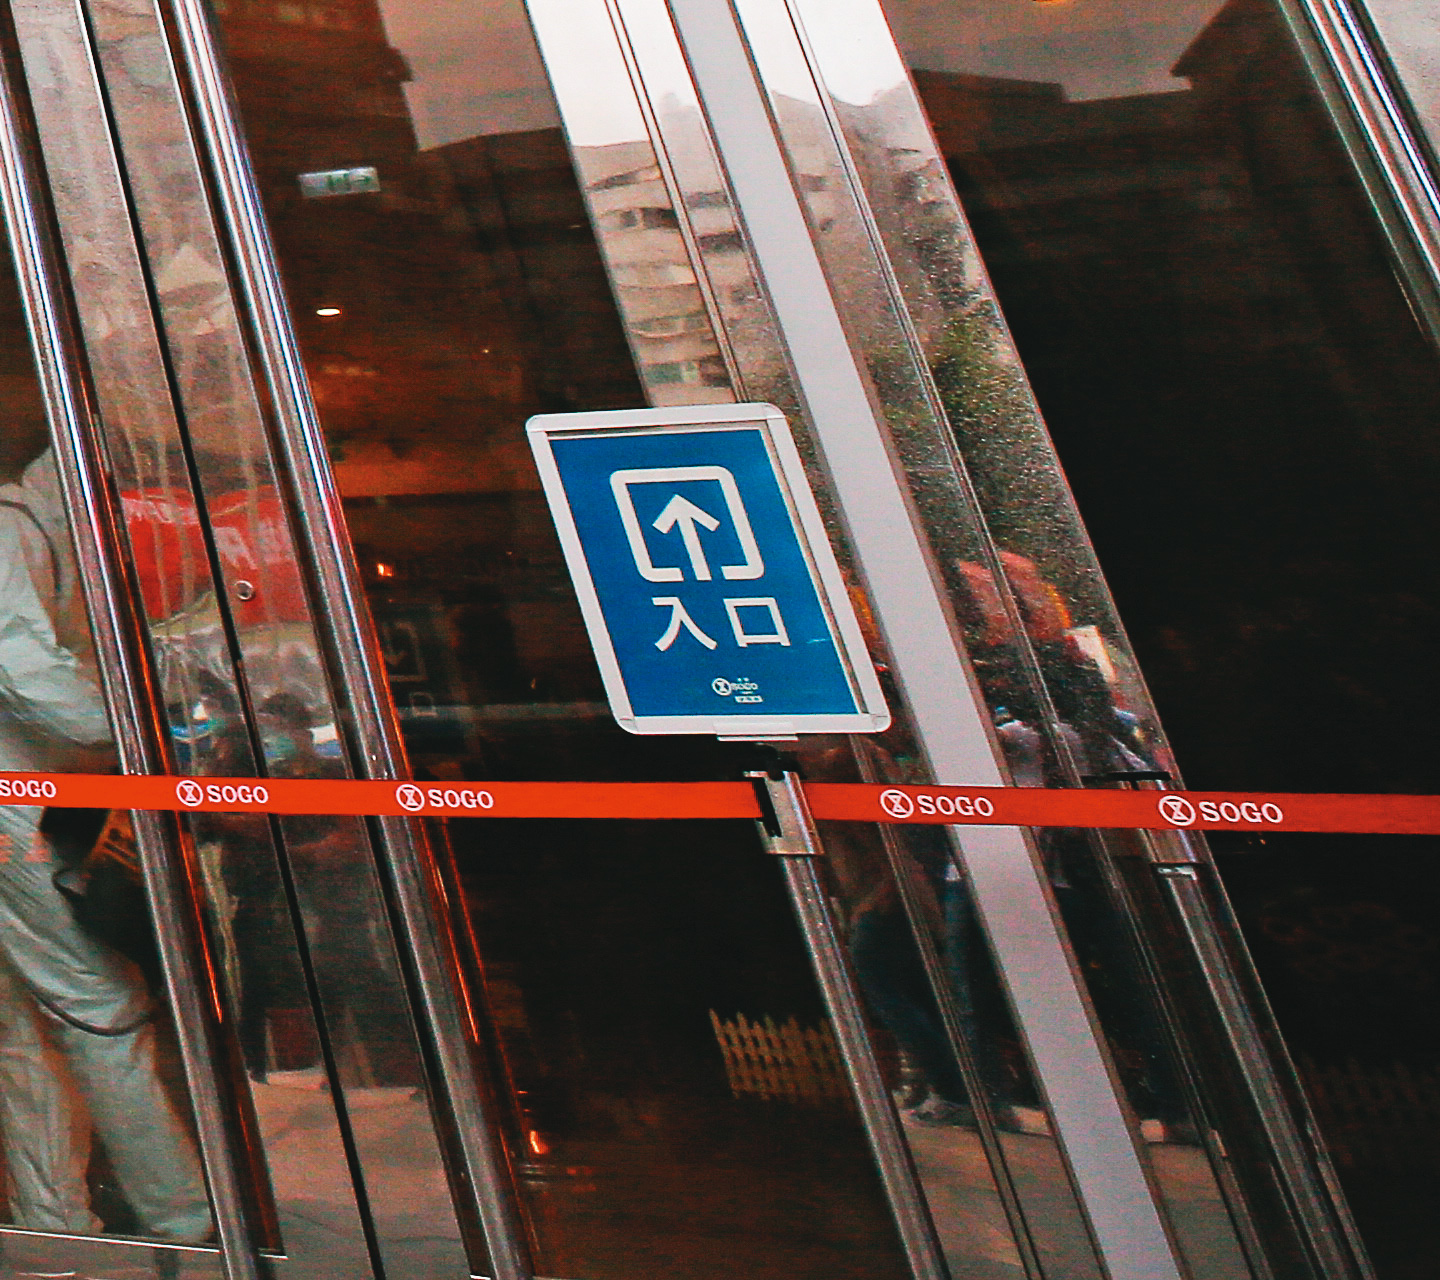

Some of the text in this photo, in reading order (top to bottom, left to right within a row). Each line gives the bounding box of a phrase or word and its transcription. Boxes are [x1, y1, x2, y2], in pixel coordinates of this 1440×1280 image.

[651, 594, 792, 652] 入口
[207, 784, 269, 804] SOGO
[428, 789, 494, 810] SOGO
[917, 795, 994, 817] SOGO
[1200, 801, 1283, 824] SOGO
